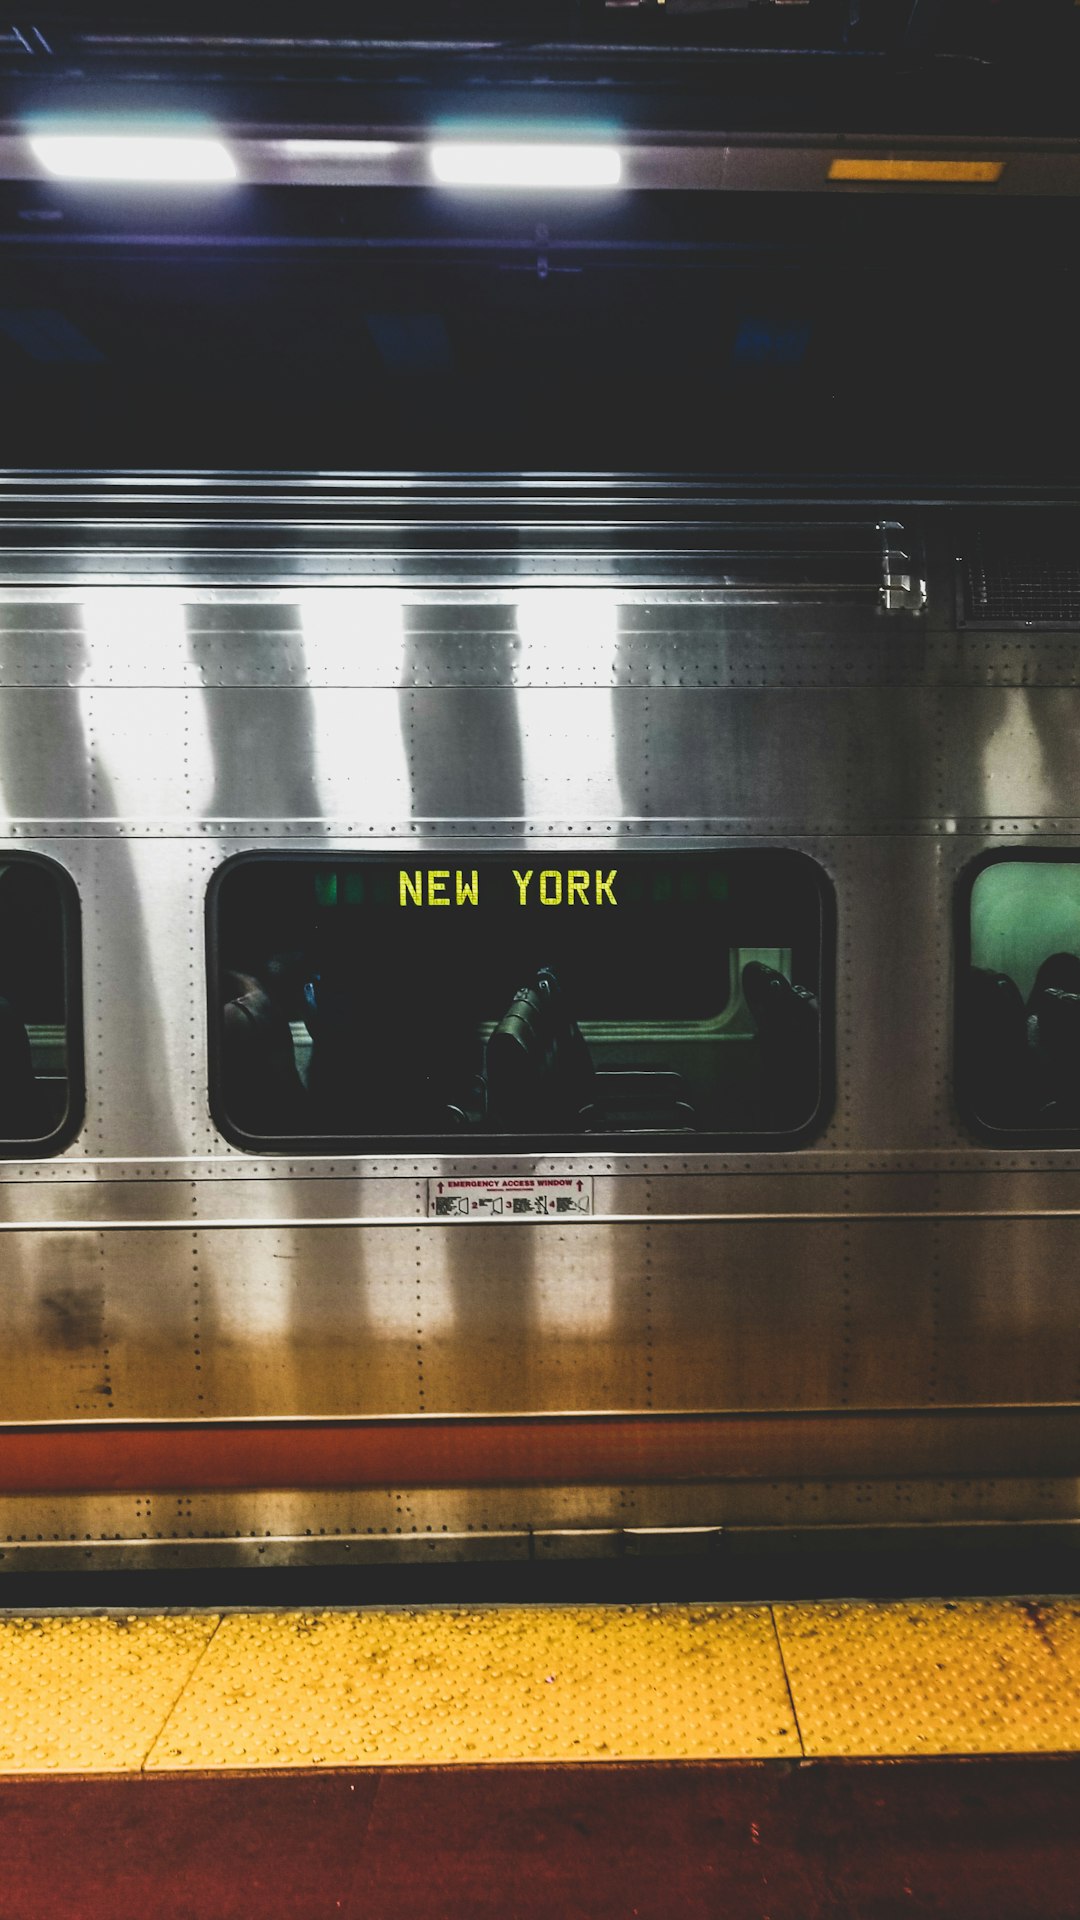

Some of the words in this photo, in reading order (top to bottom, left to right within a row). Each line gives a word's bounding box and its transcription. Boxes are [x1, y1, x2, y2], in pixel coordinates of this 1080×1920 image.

[399, 870, 479, 906] NEW
[512, 869, 618, 906] YORK
[506, 1201, 512, 1209] 3
[549, 1200, 555, 1208] 4
